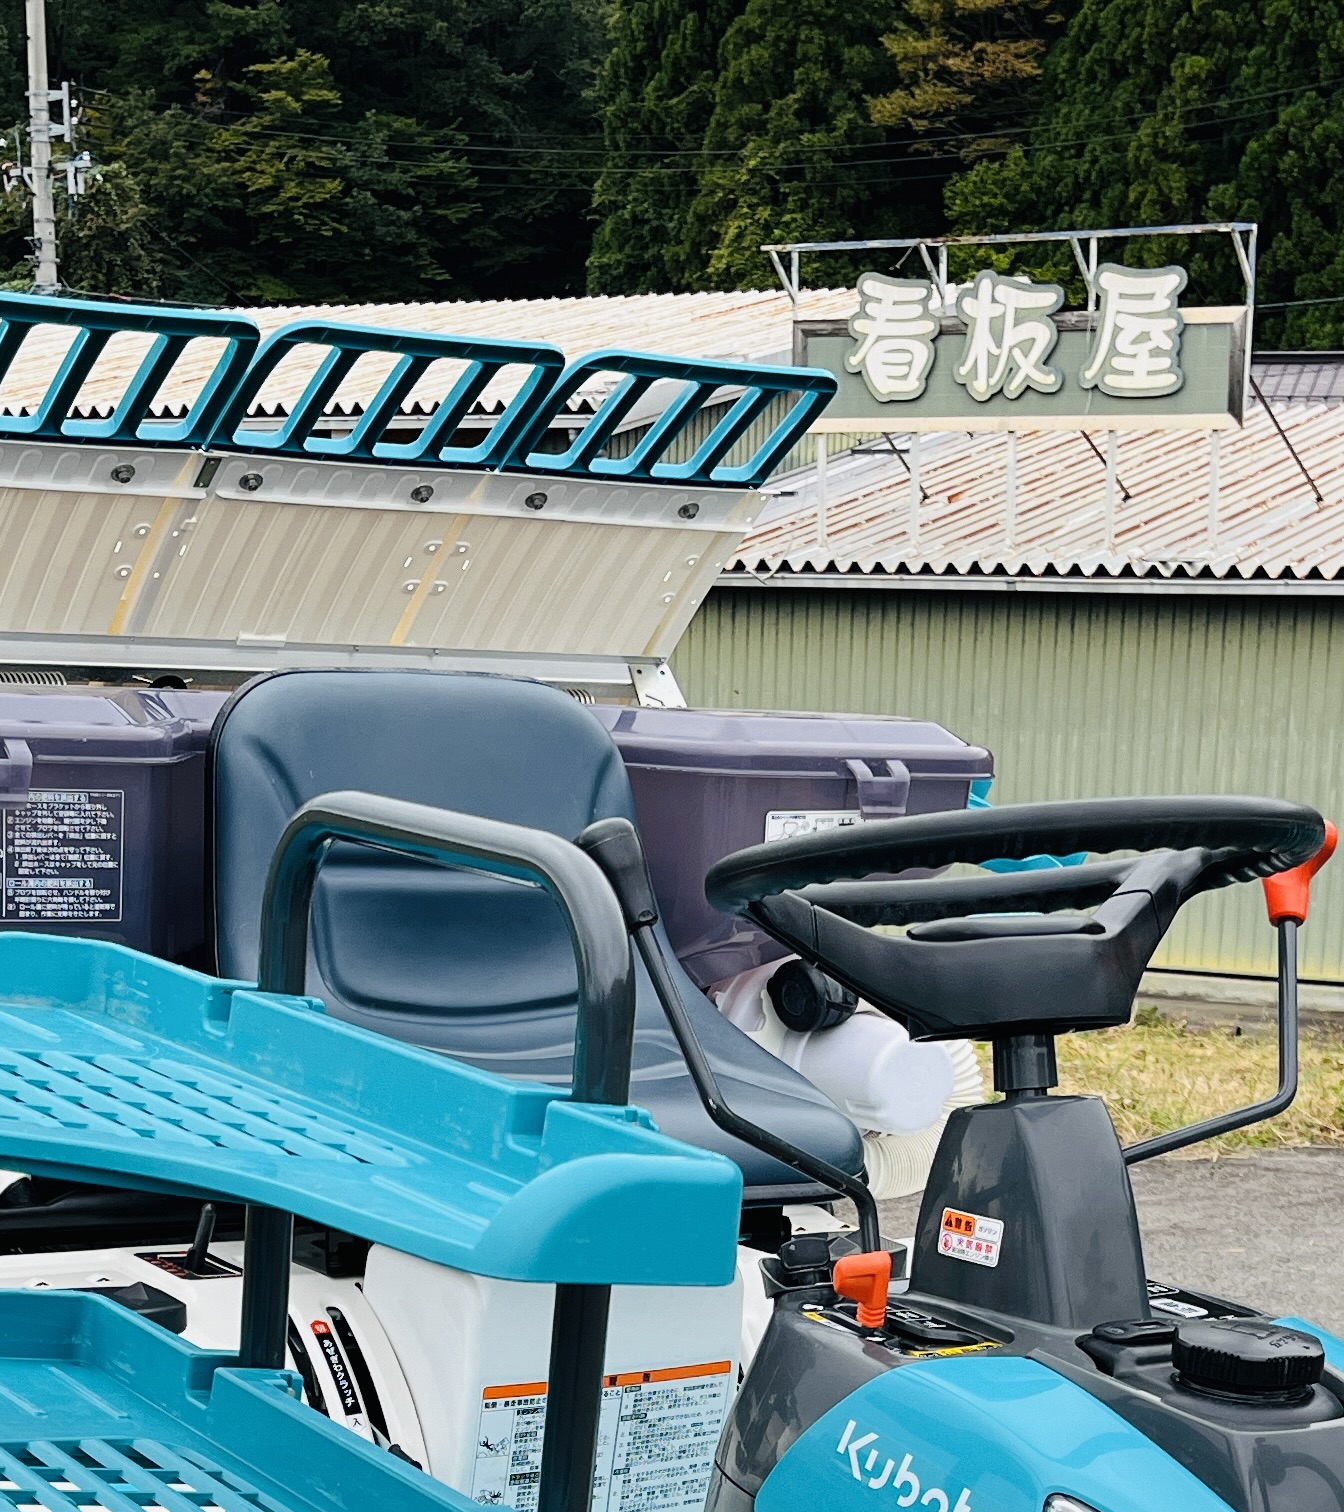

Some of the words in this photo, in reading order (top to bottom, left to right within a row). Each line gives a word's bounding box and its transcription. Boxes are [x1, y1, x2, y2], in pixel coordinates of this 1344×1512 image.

[846, 266, 1184, 399] 看板屋
[322, 1338, 356, 1408] あぜぎわクラッチ
[352, 1417, 362, 1428] 入
